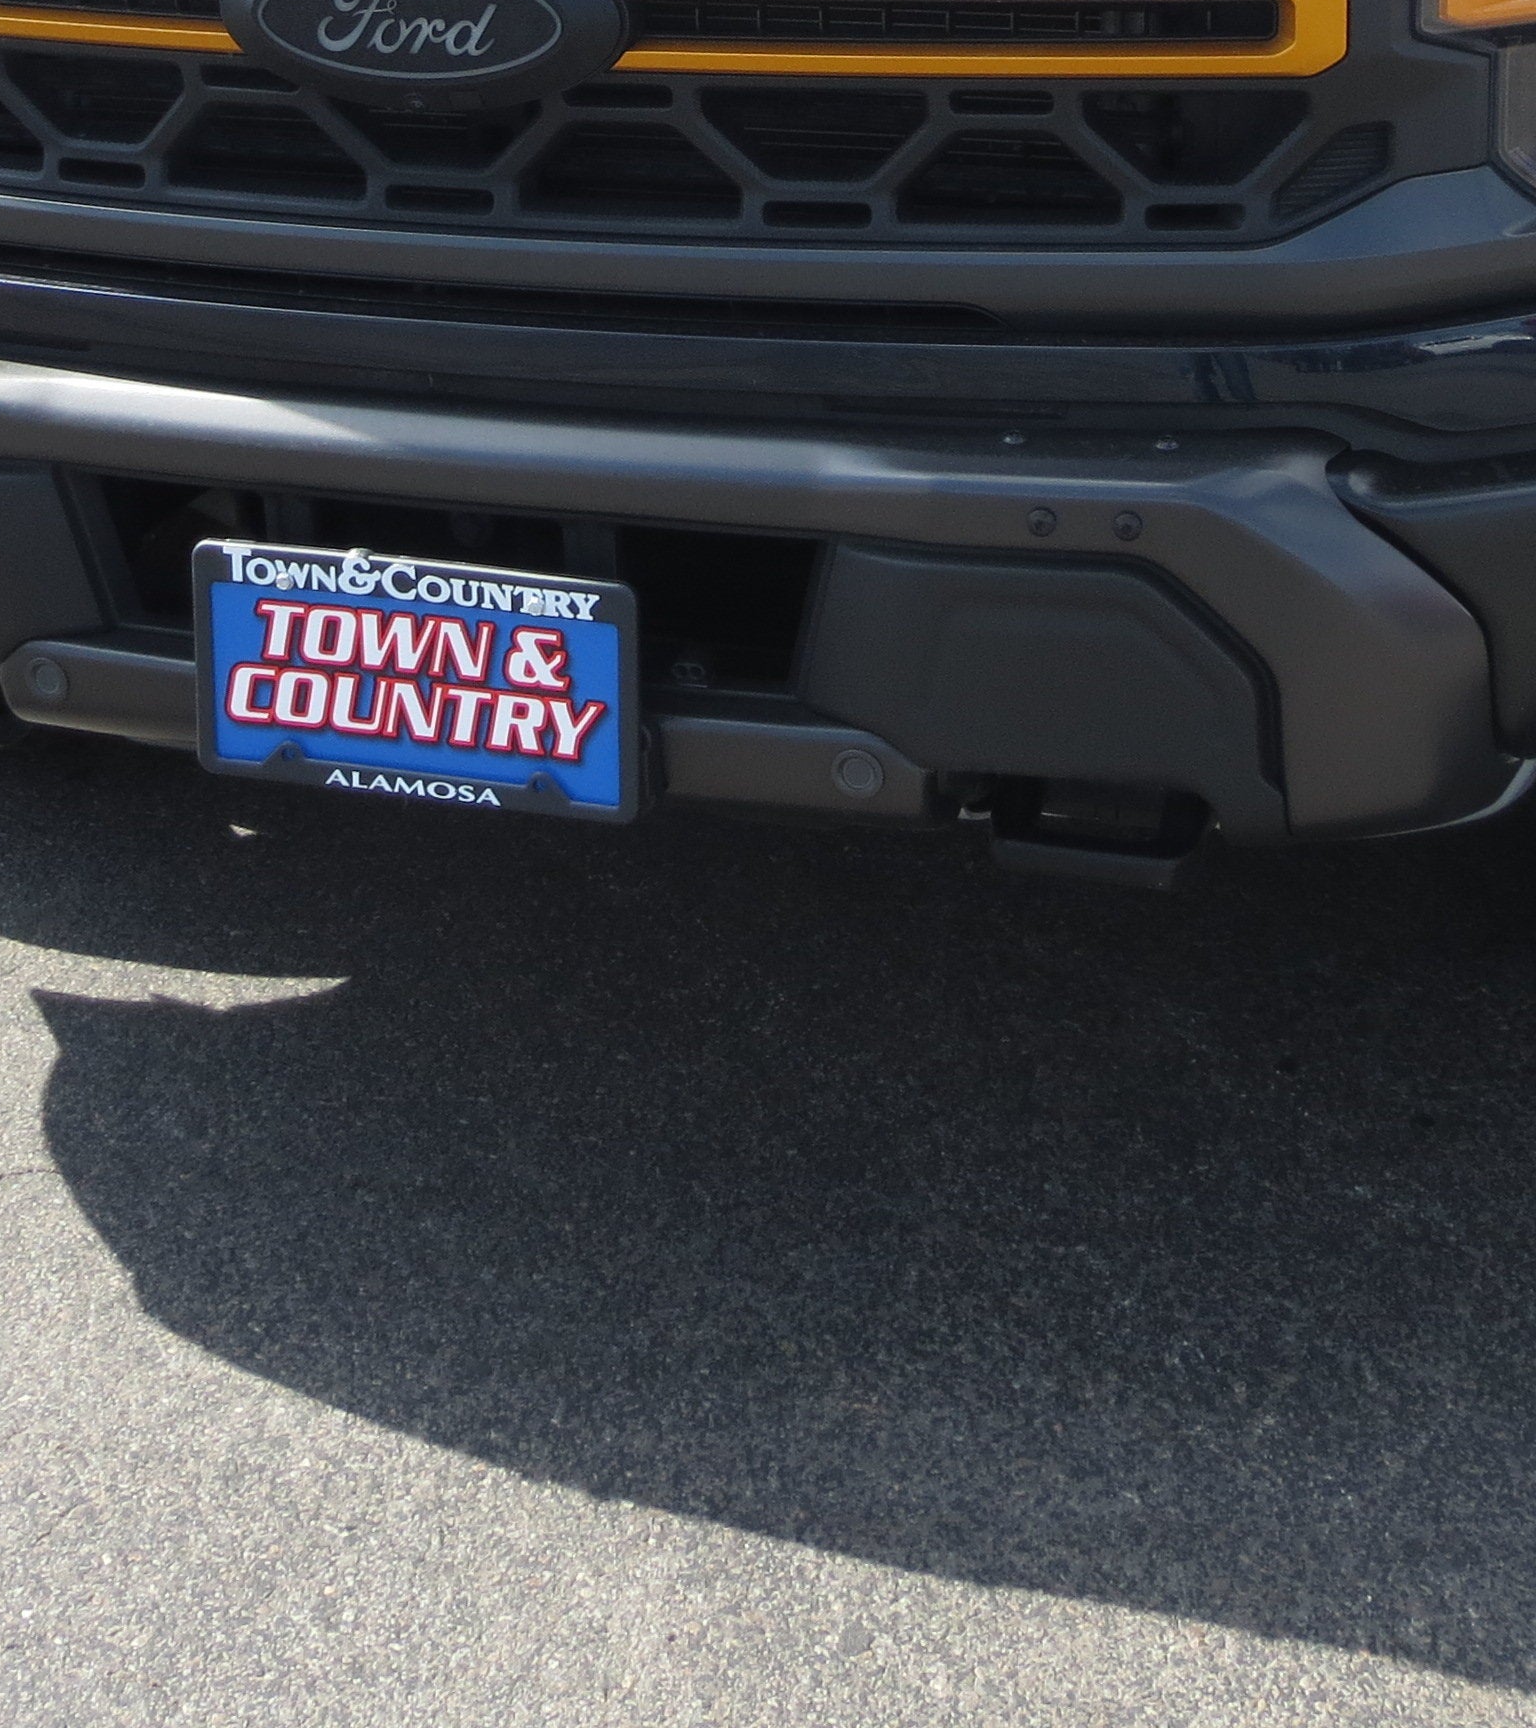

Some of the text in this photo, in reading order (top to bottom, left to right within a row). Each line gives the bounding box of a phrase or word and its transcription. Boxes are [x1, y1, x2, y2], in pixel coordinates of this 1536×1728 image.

[254, 599, 571, 691] TOWN &
[226, 662, 606, 761] COUNTRY
[324, 768, 502, 808] ALAMOSA
